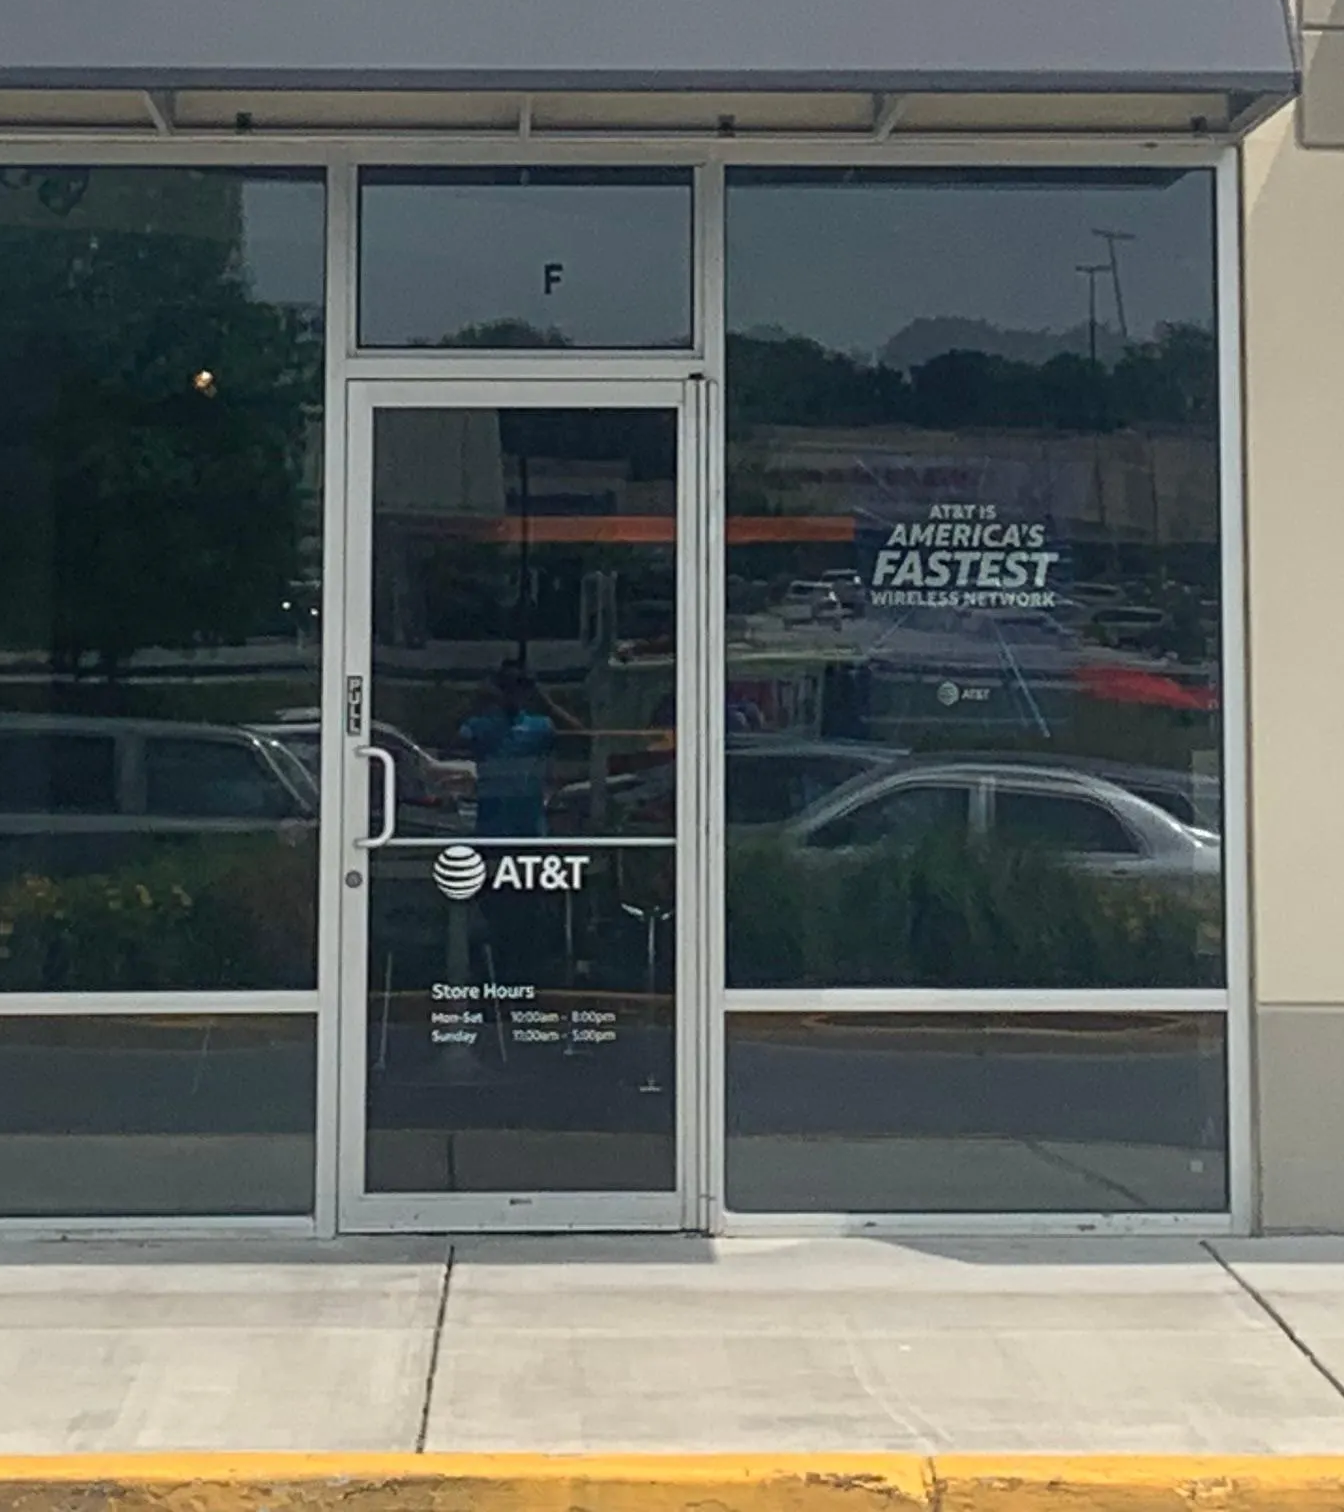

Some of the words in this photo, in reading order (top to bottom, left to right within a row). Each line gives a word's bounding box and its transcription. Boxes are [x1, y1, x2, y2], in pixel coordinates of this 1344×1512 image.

[544, 263, 564, 295] F
[929, 504, 976, 520] AT&T
[979, 504, 997, 520] IS
[887, 523, 1046, 548] AMERICA'S
[870, 550, 1060, 588] FASTEST
[870, 590, 959, 608] WIRELESS
[960, 590, 1056, 608] NETWORK
[348, 676, 362, 735] PULL
[492, 855, 591, 890] AT&T
[431, 983, 481, 1000] Store
[483, 982, 536, 1000] Hours
[431, 1029, 477, 1045] Sunday
